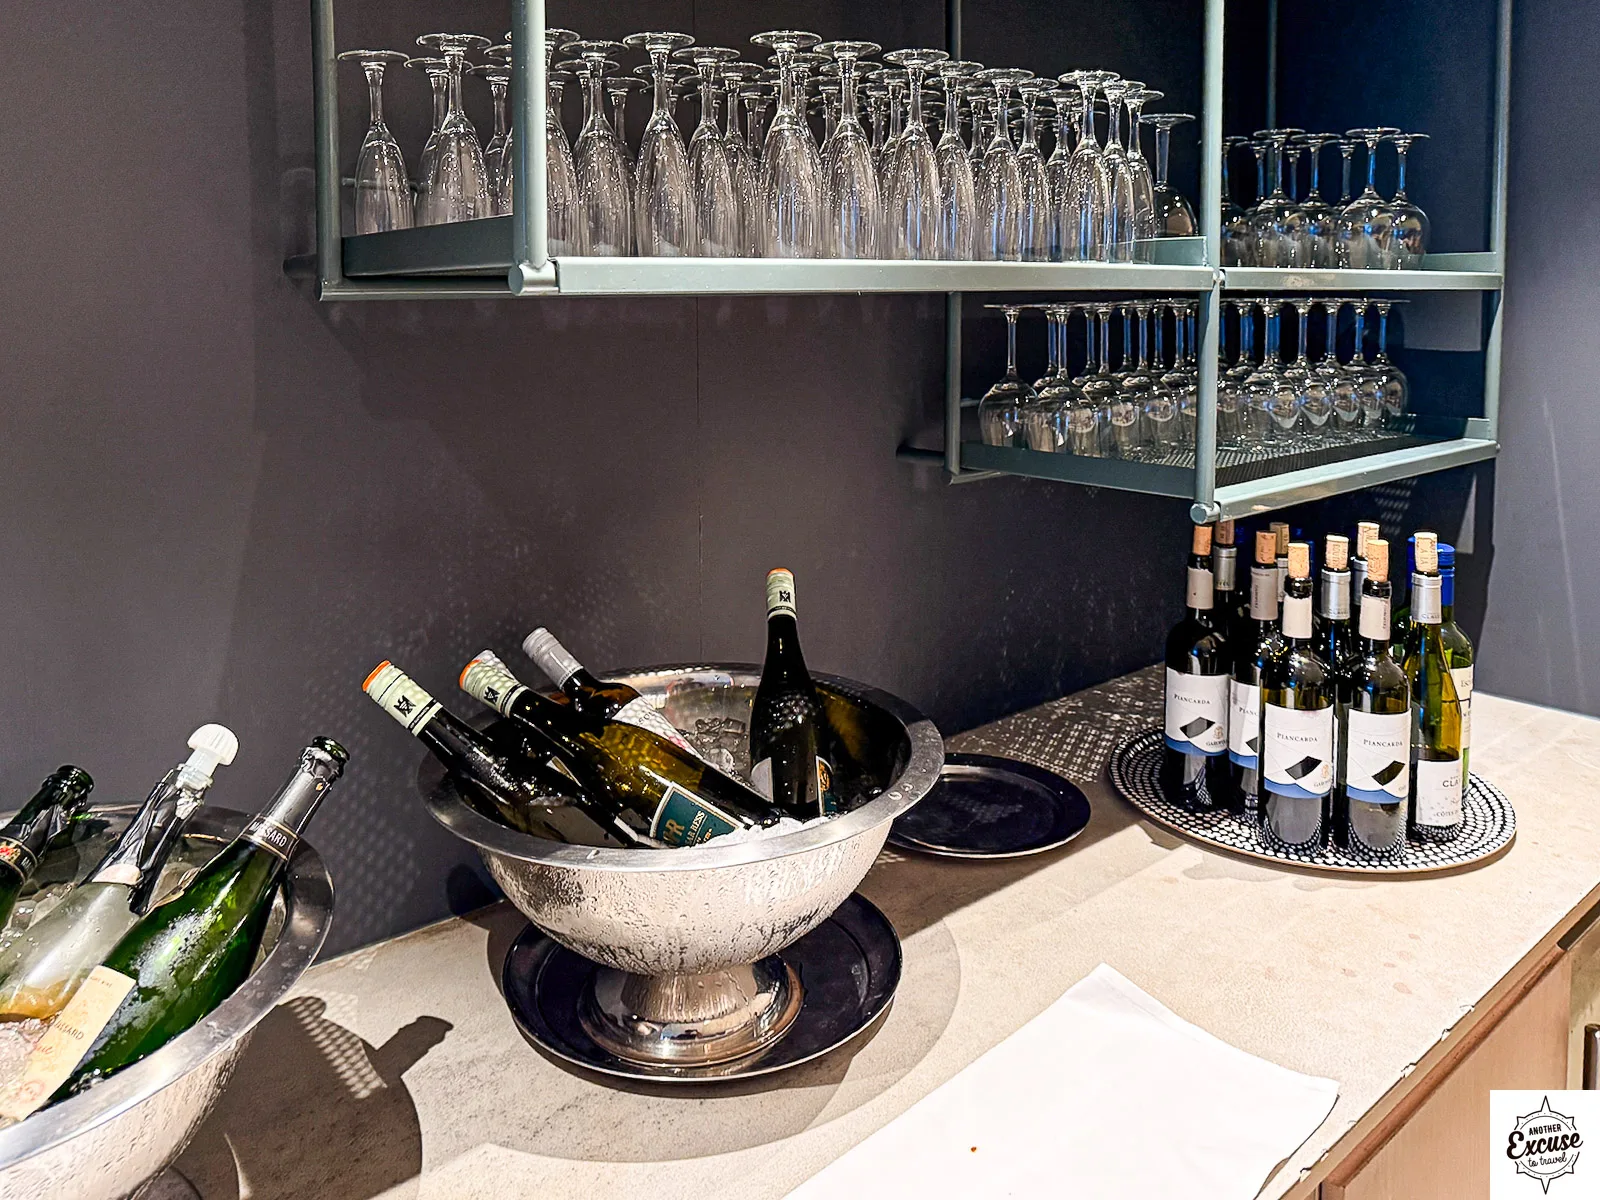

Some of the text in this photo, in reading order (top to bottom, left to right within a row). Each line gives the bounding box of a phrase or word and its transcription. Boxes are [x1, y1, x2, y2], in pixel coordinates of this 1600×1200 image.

[1174, 693, 1211, 705] PIANCARDA
[1239, 706, 1259, 716] PIANC
[1277, 732, 1318, 742] PIANCARDA
[1363, 738, 1403, 747] PIANCARDA
[1442, 778, 1460, 788] CLA
